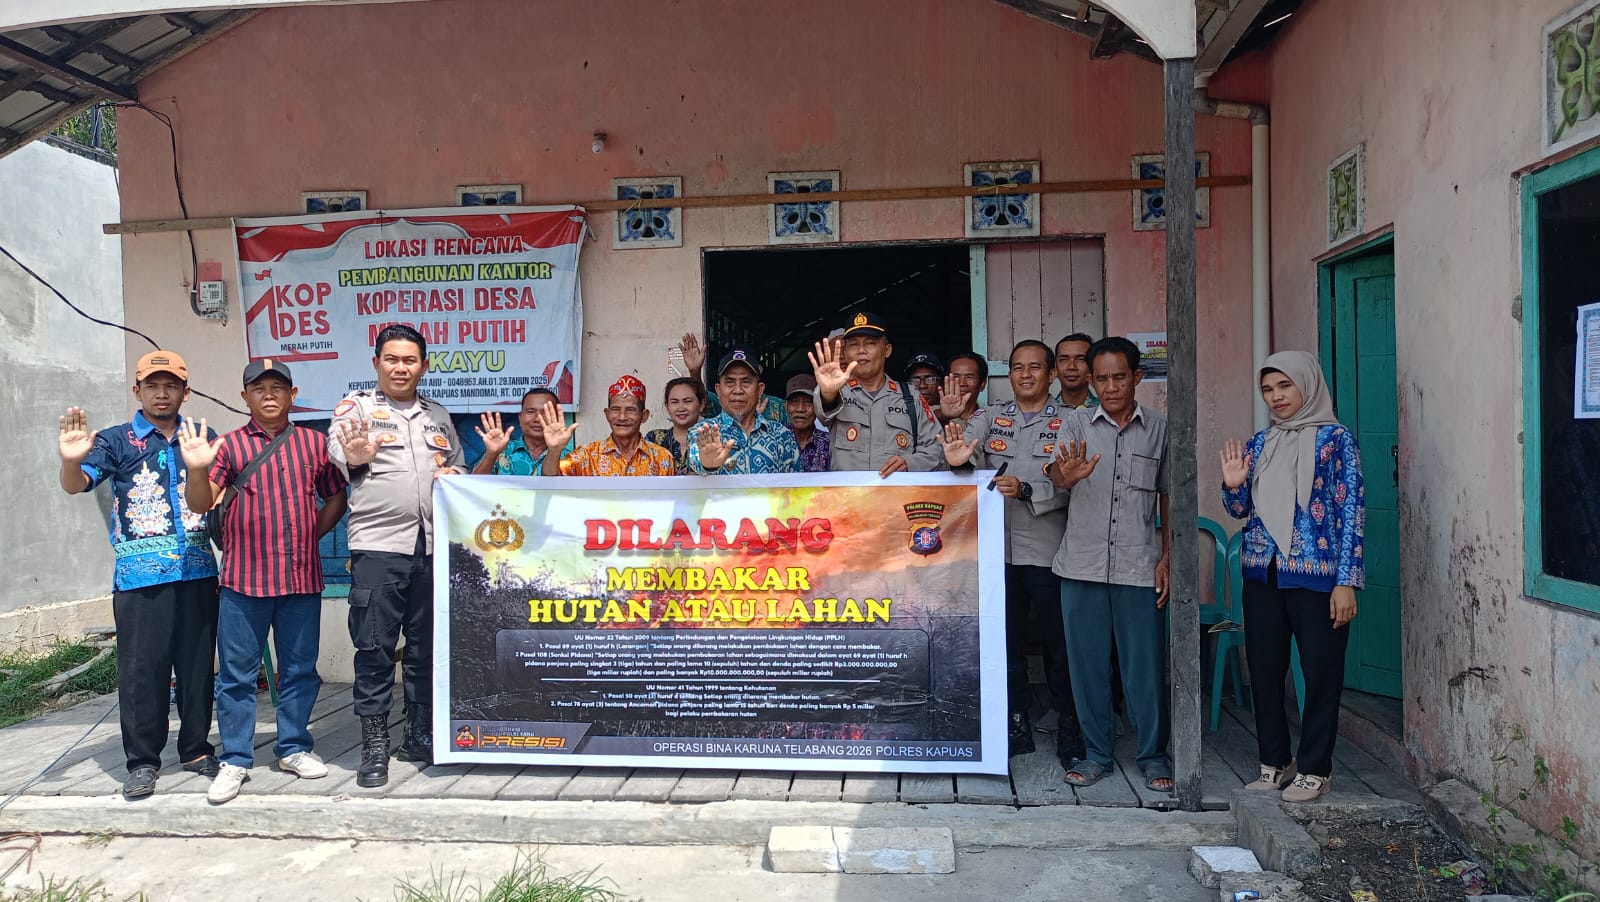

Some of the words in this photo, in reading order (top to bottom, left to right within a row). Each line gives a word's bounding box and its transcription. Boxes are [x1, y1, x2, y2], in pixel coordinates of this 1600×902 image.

[364, 239, 426, 259] LOKASI
[434, 236, 523, 256] RENCANA
[339, 264, 474, 287] PEMBANGUNAN
[478, 262, 552, 280] KANTOR
[275, 282, 331, 308] KOP
[356, 288, 464, 315] KOPERASI
[474, 287, 536, 310] DESA
[278, 310, 330, 337] DES
[369, 321, 448, 347] MAH
[458, 320, 525, 344] PUTIH
[280, 342, 308, 351] MERAH
[310, 341, 333, 350] PUTIH
[428, 350, 505, 373] KAYU
[530, 376, 547, 384] 2025
[432, 388, 459, 398] KAPUAS
[888, 406, 908, 414] POL
[583, 518, 834, 550] DILARANG
[606, 567, 810, 591] MEMBAKAR
[528, 599, 652, 623] HUTAN
[662, 599, 756, 622] ATAU
[766, 599, 892, 622] LAHAN
[481, 736, 566, 747] PRESISI
[653, 742, 703, 753] OPERASI
[706, 743, 732, 753] BINA
[734, 744, 781, 754] KARUNA
[784, 744, 844, 756] TELABANG
[846, 746, 872, 756] 2026
[876, 746, 923, 757] POLRES
[926, 747, 973, 758] KAPUAS
